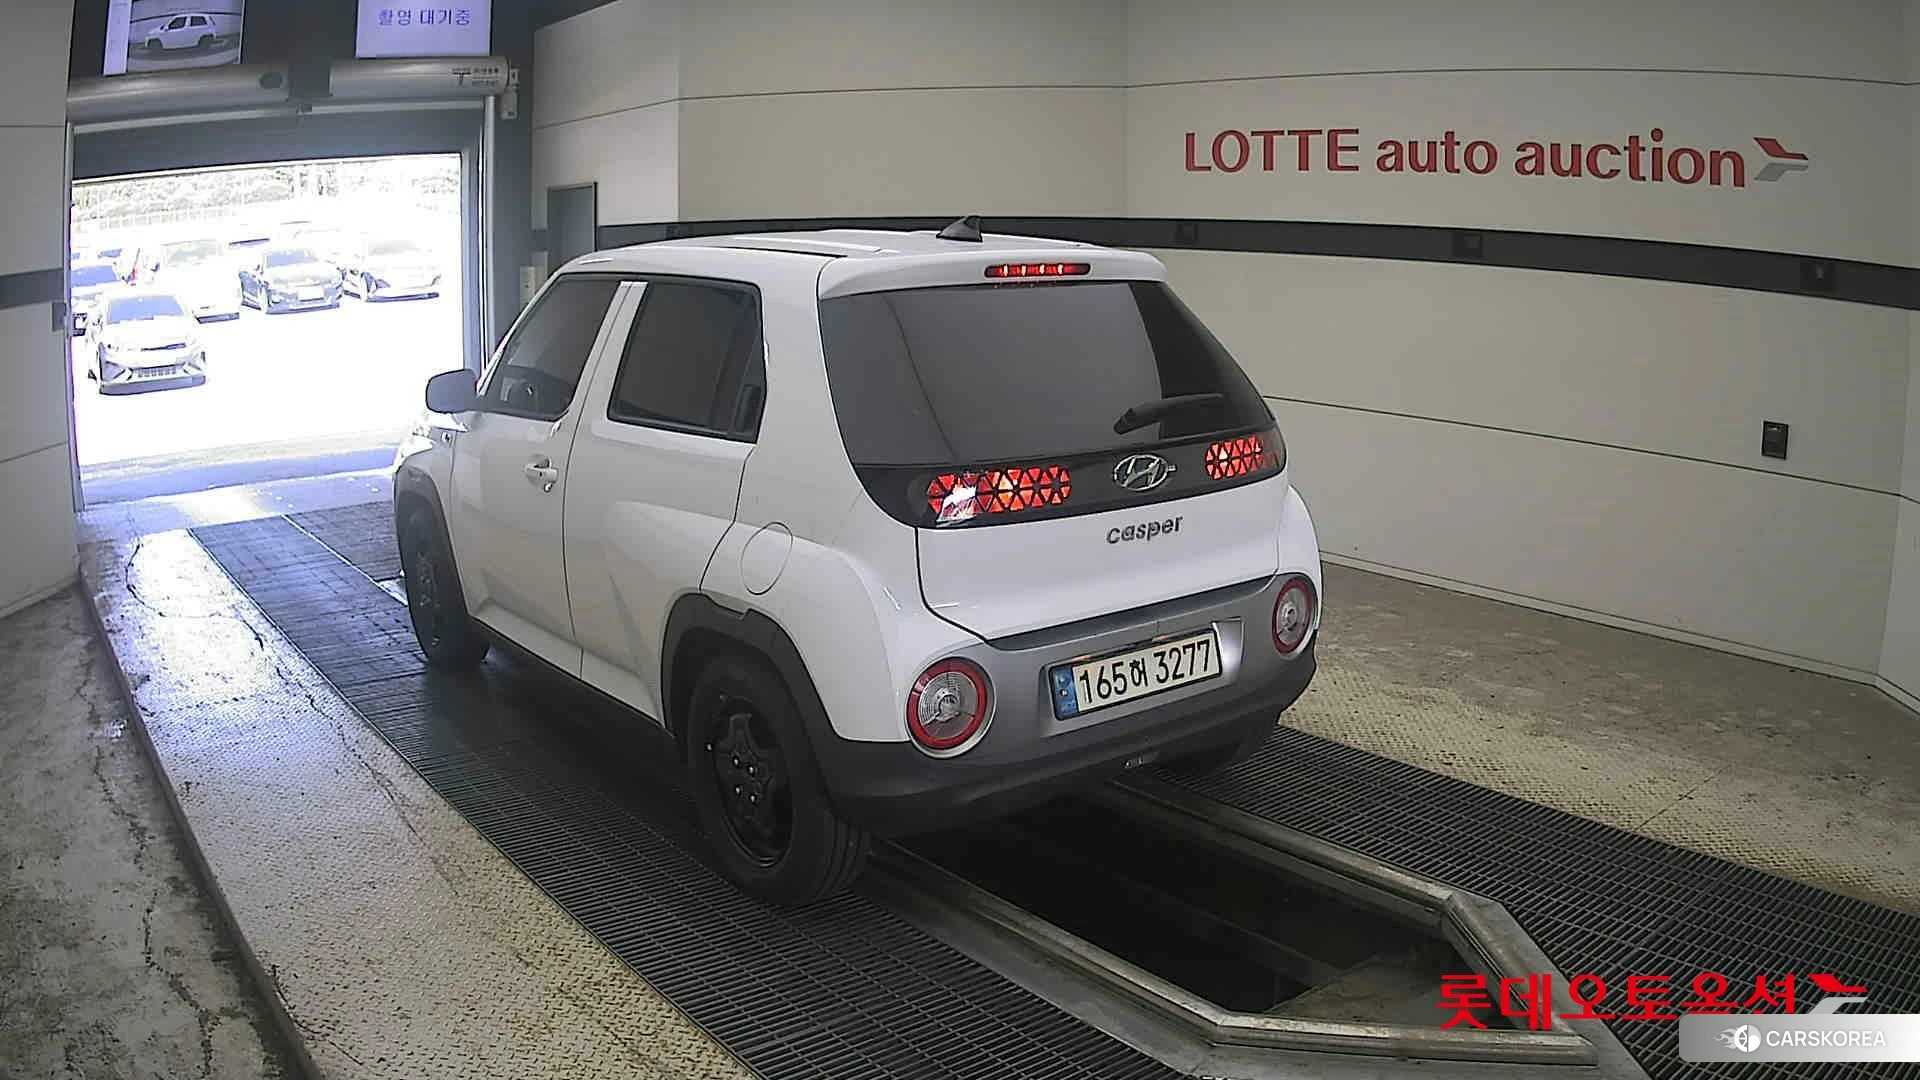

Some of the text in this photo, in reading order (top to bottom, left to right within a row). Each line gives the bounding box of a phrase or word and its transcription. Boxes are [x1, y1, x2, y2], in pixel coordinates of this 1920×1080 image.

[378, 8, 471, 26] 촬영 대기중
[1185, 128, 1746, 188] LOTTE auto auction
[1106, 516, 1184, 545] casper
[1079, 638, 1211, 704] 165허 3277
